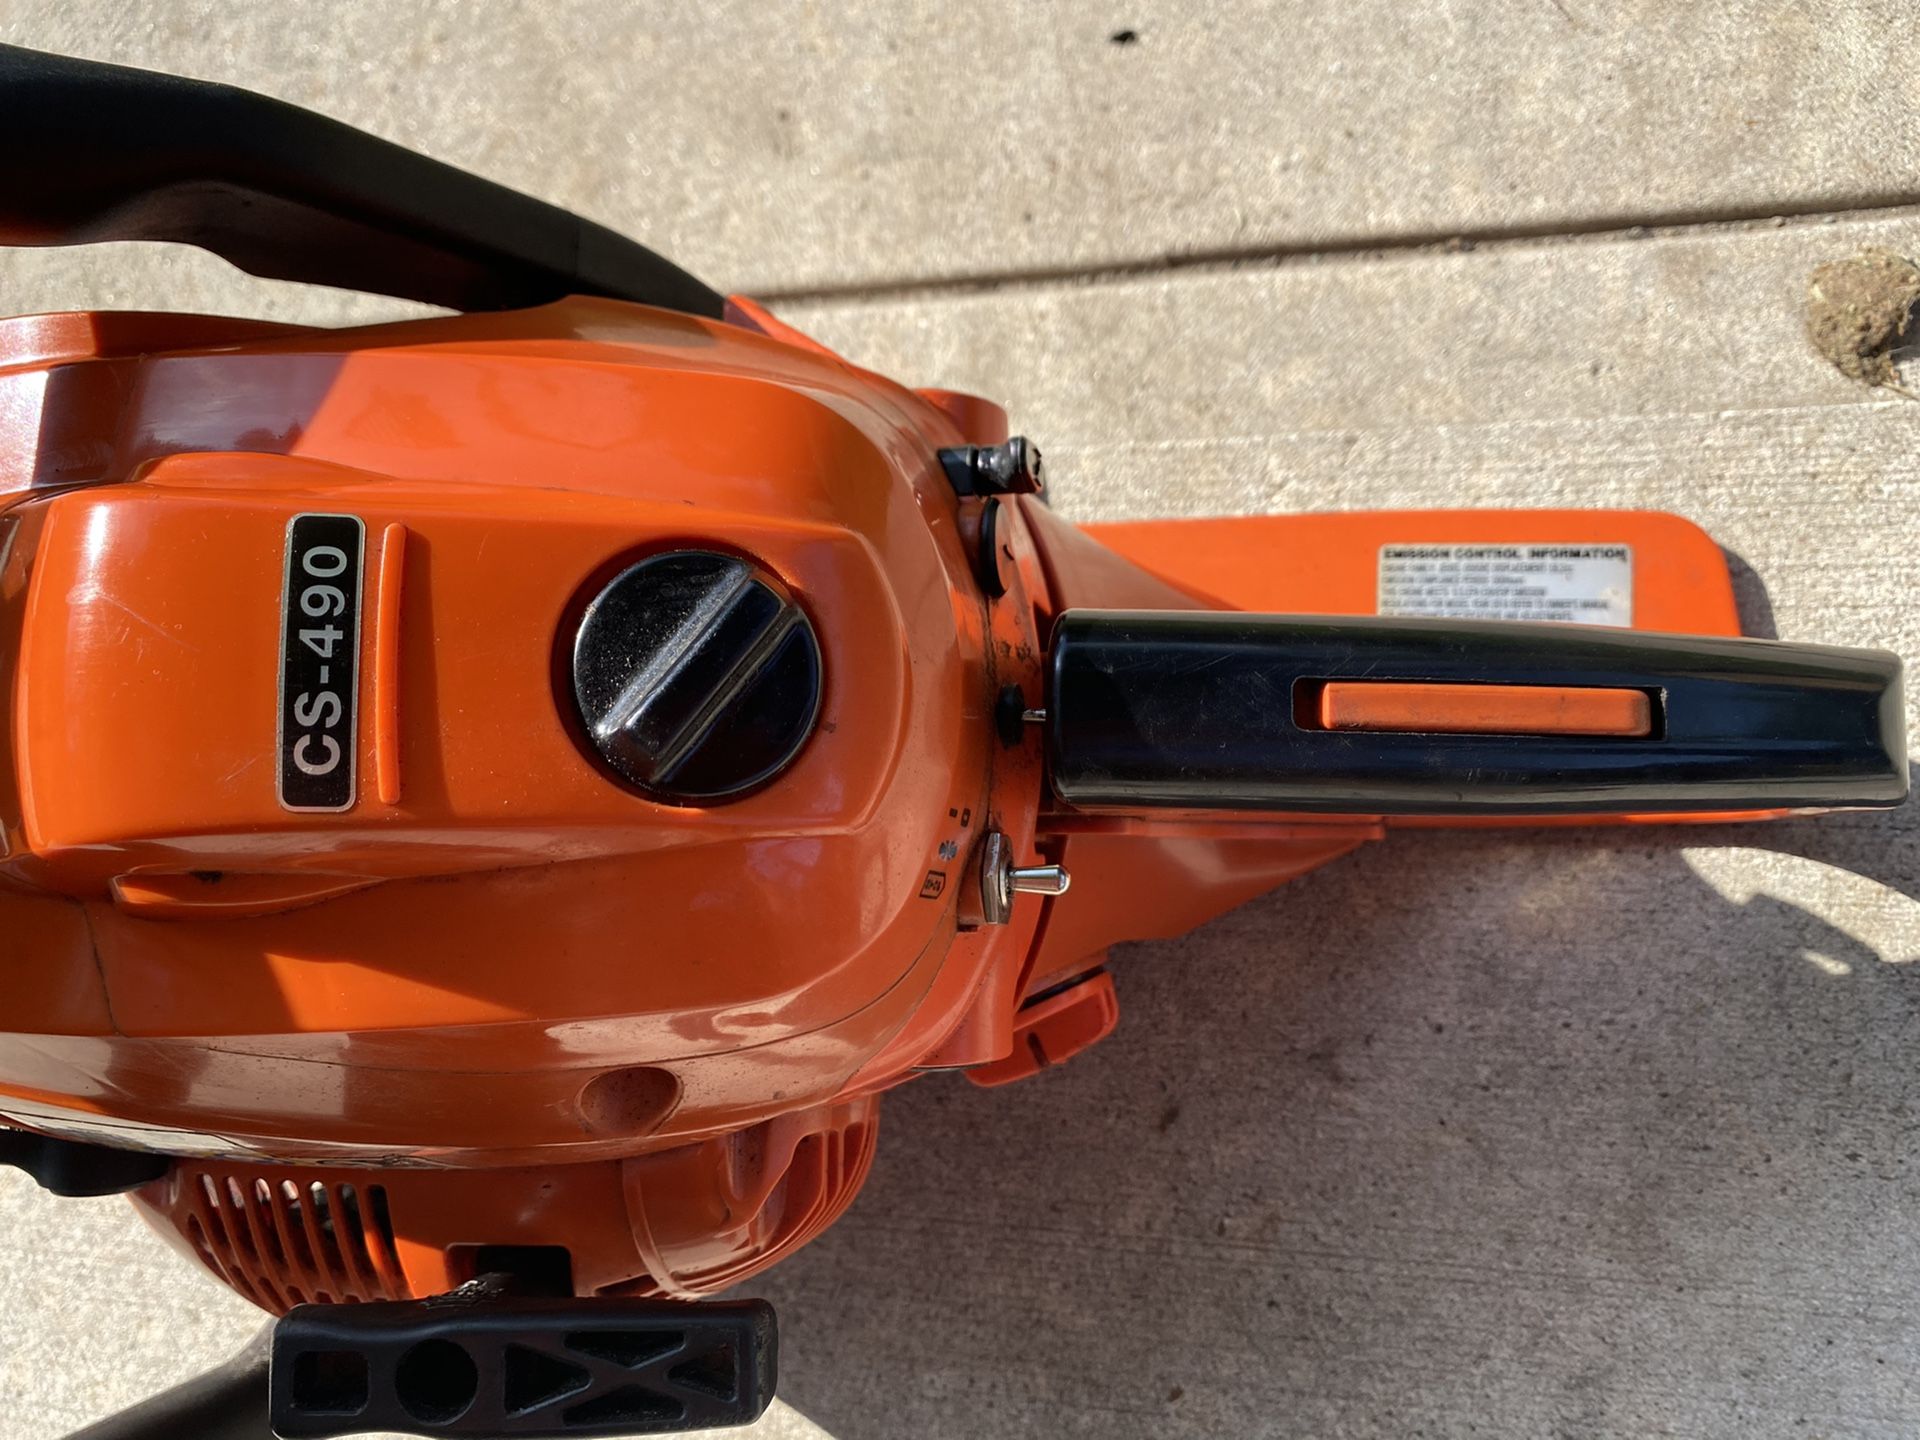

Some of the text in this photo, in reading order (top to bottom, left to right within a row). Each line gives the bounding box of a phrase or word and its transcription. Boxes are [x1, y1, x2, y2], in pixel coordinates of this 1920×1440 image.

[1384, 549, 1626, 559] EMISSION CONTROL INFORMATION
[293, 546, 347, 775] CS-490
